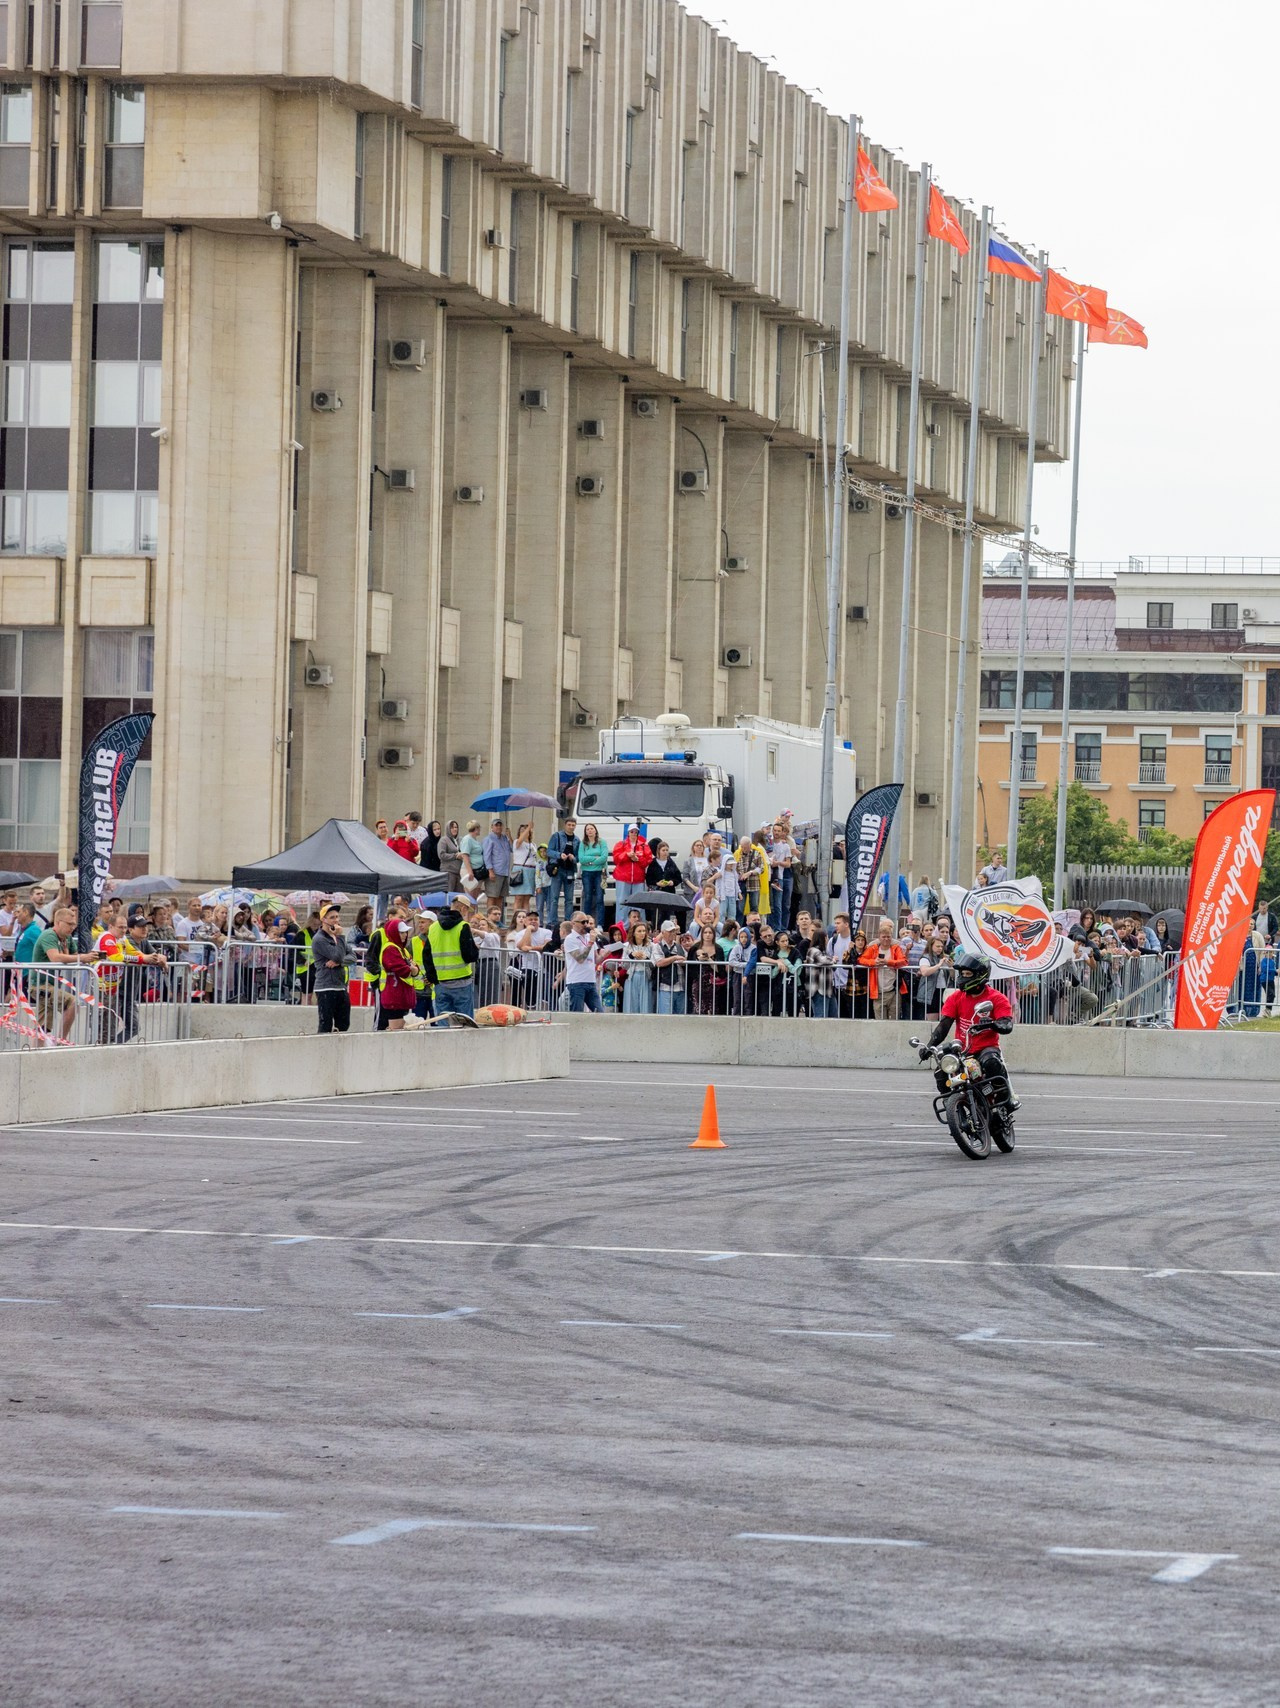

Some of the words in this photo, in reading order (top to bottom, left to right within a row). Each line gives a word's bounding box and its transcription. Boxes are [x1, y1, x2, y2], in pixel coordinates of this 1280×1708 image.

[1184, 805, 1261, 1027] Автострада
[1189, 902, 1207, 943] ОТКРЫТЫЙ
[1203, 835, 1233, 901] АВТОМОБИЛЬНЫЙ
[1195, 901, 1215, 945] ФЕСТИВАЛЬ
